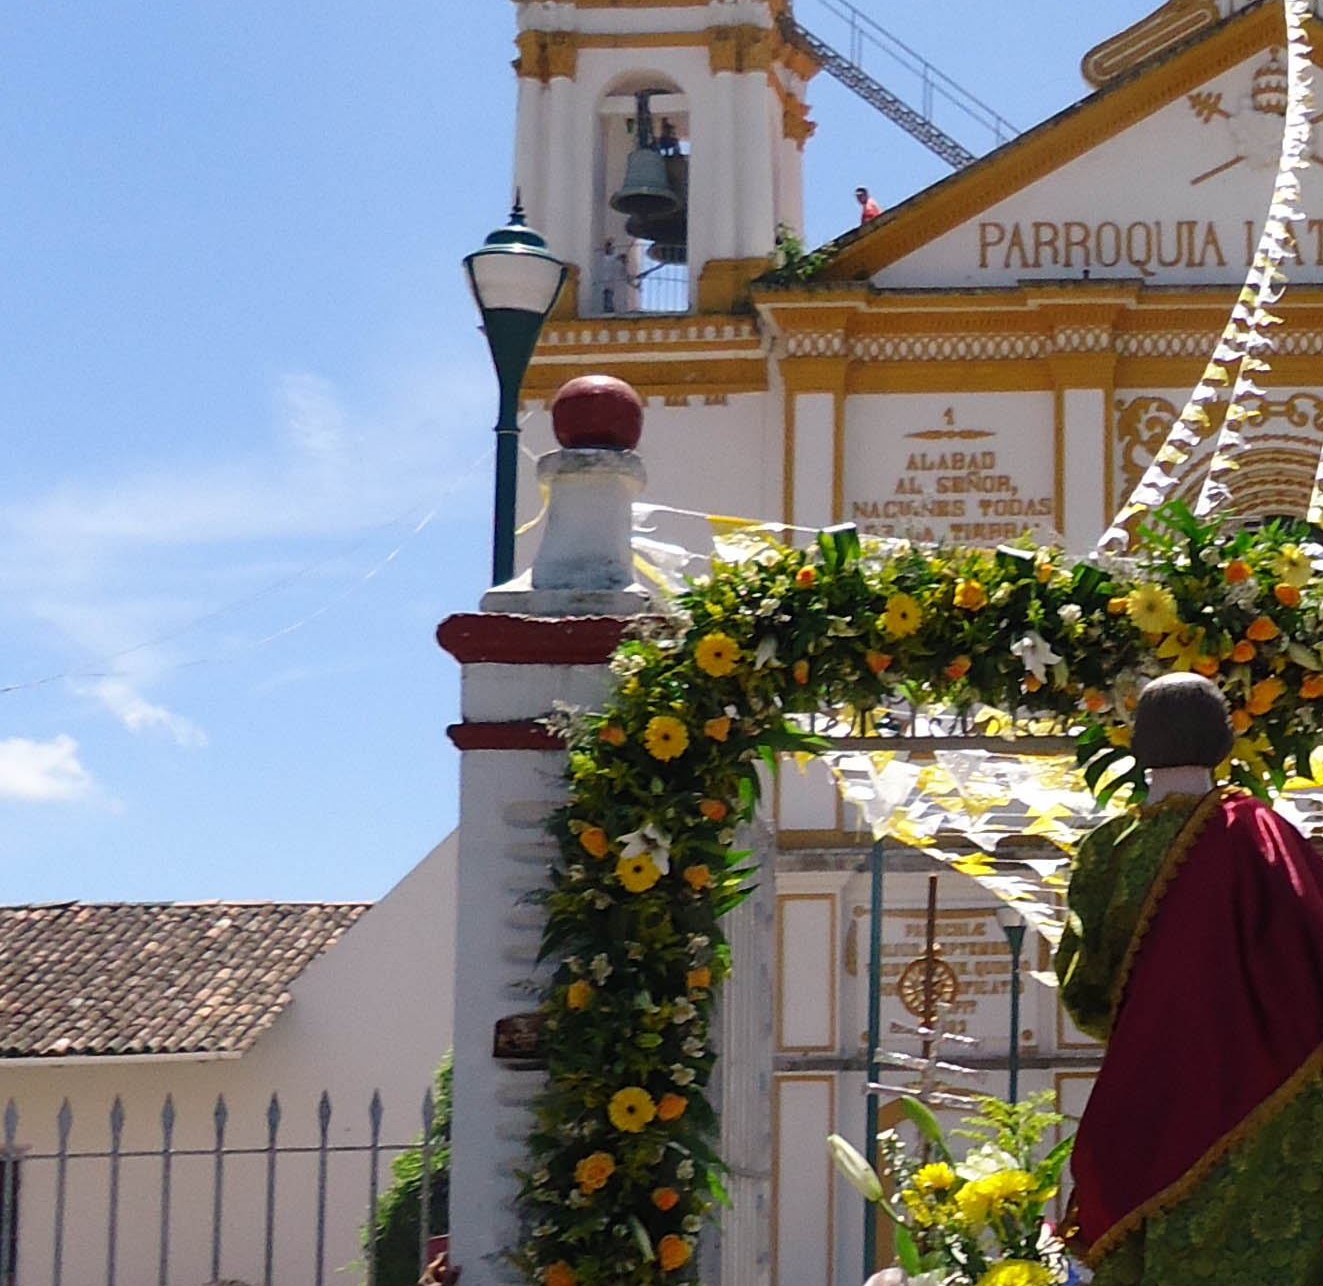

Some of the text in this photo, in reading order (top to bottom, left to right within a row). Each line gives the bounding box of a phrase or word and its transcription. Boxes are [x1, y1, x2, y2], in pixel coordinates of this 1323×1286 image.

[979, 220, 1227, 276] PARROQUIA
[943, 407, 955, 426] 1
[906, 451, 996, 471] ALABAD
[895, 471, 1019, 497] AL SEÑOR,
[979, 497, 1052, 517] TODAS
